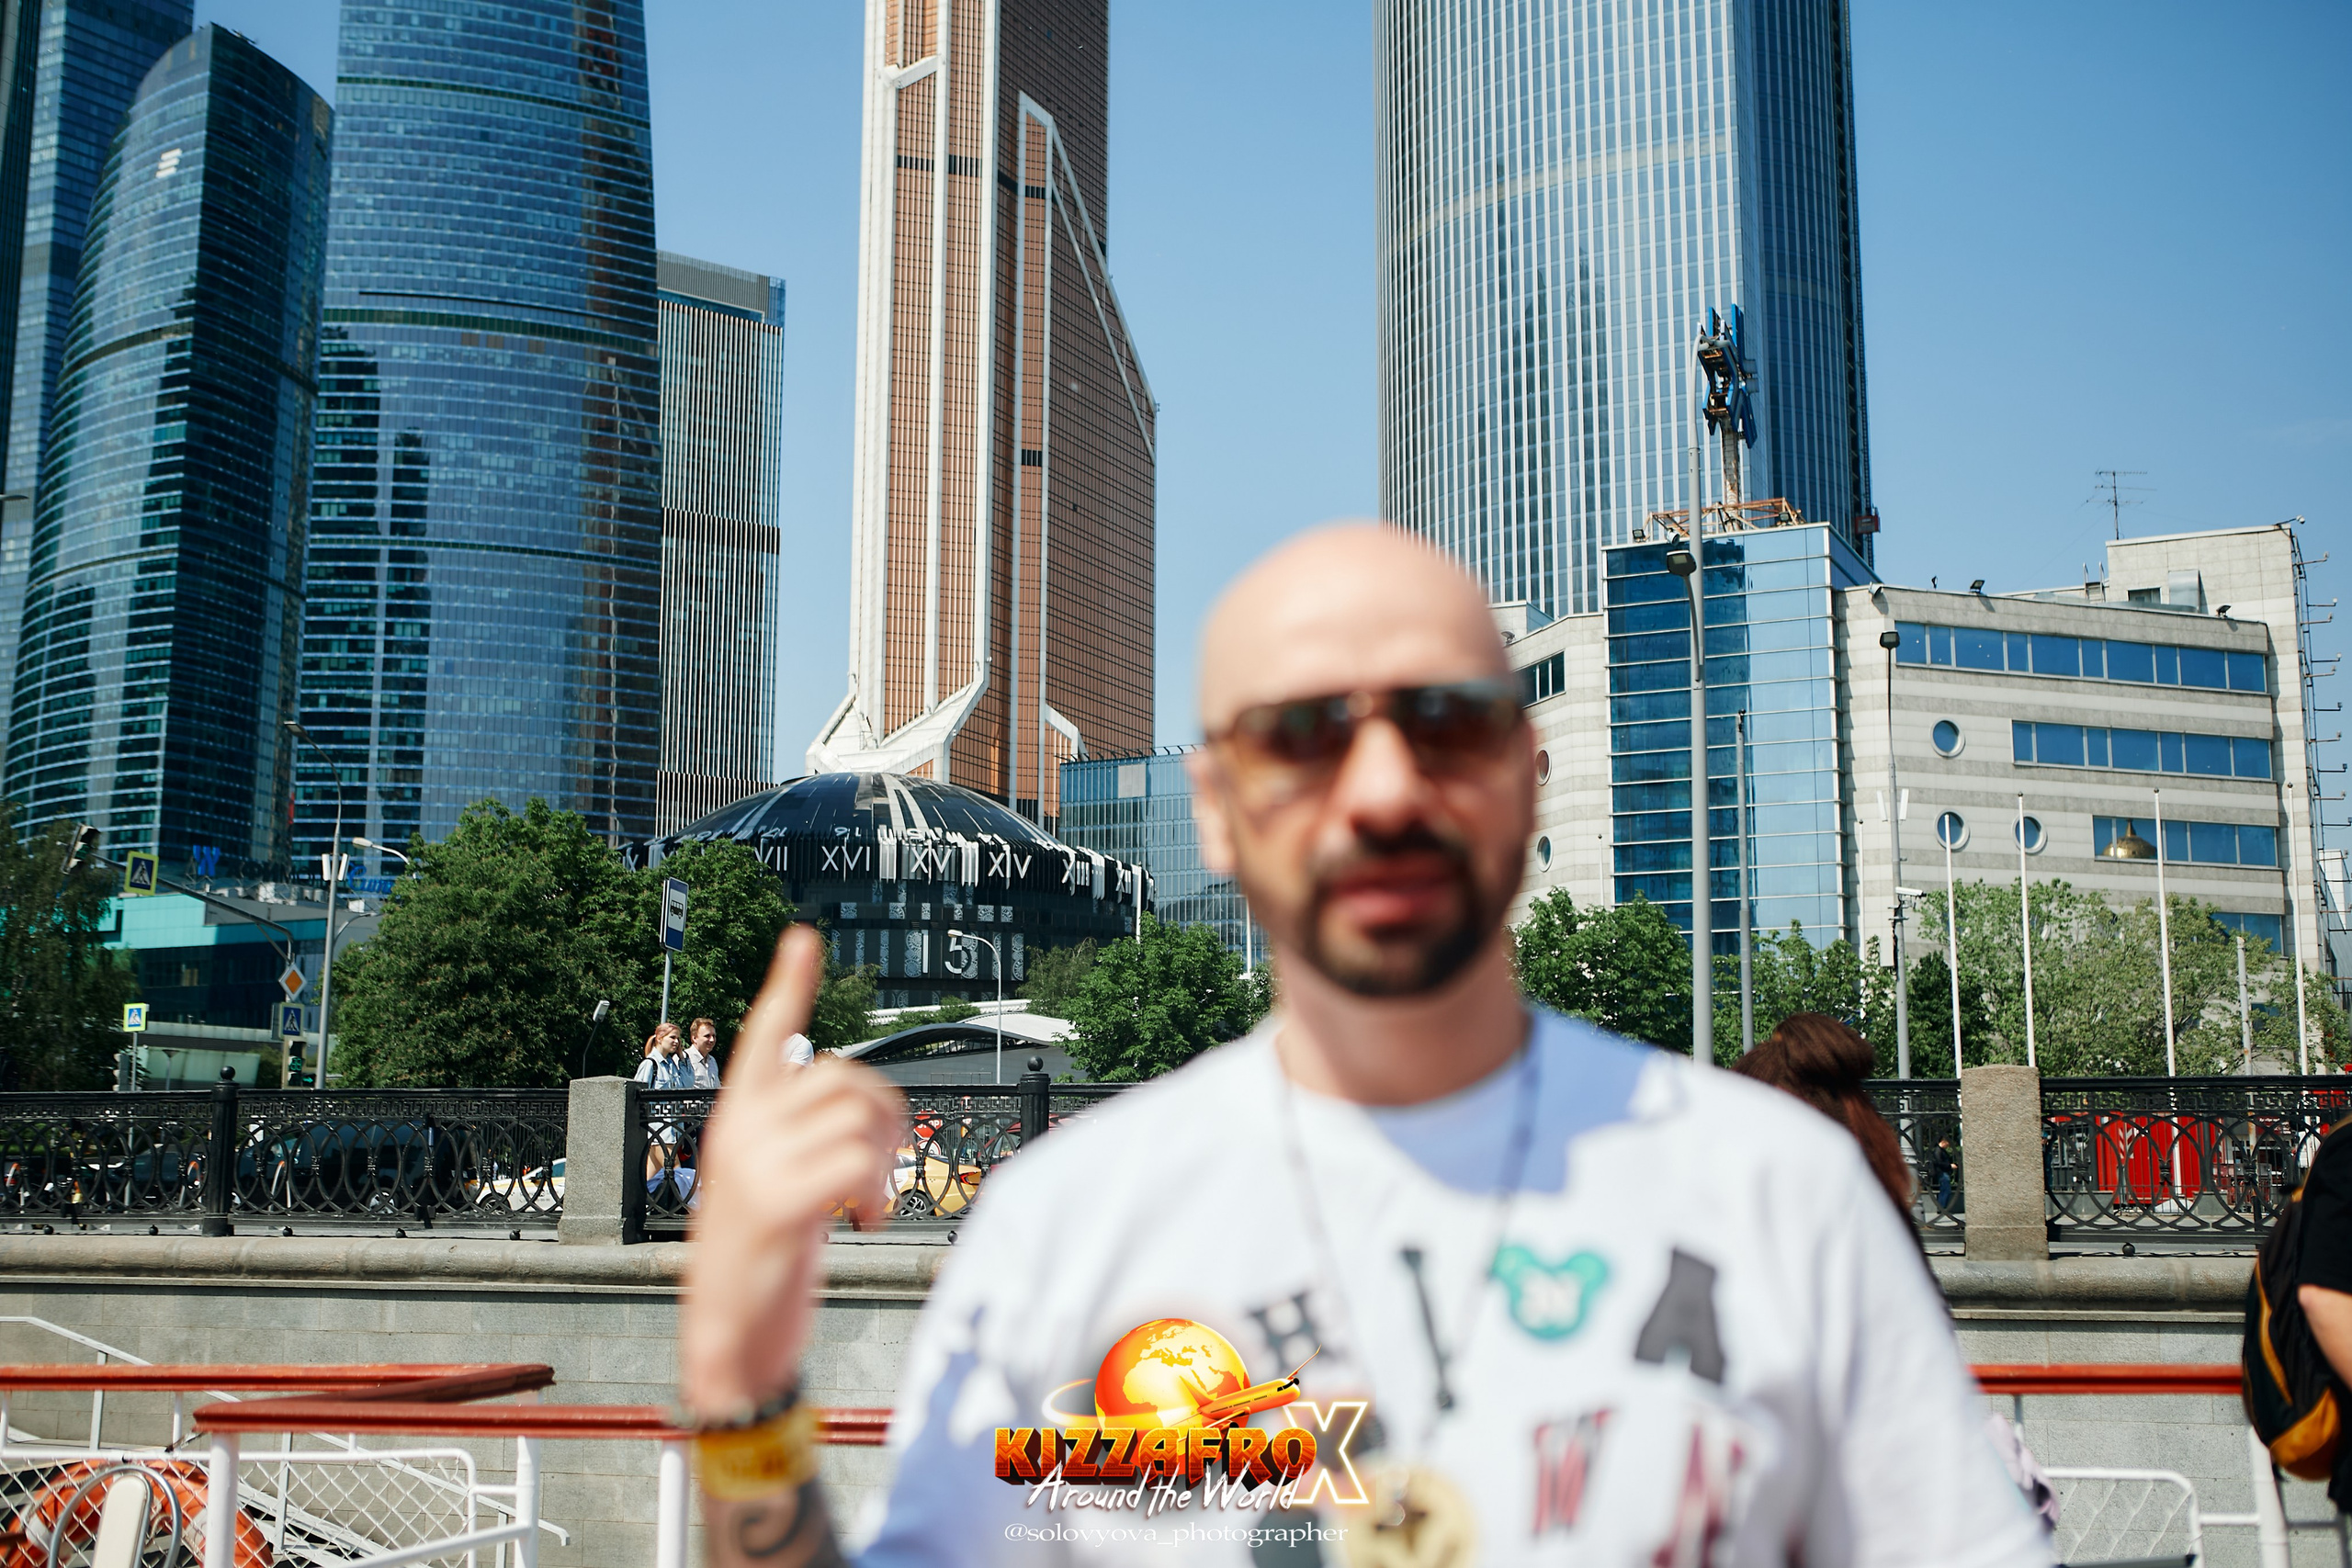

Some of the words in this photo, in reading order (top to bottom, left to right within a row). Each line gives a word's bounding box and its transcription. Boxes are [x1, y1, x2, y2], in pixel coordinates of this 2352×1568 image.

[820, 846, 871, 872] XVI
[987, 852, 1033, 879] XIV
[921, 930, 973, 974] 15
